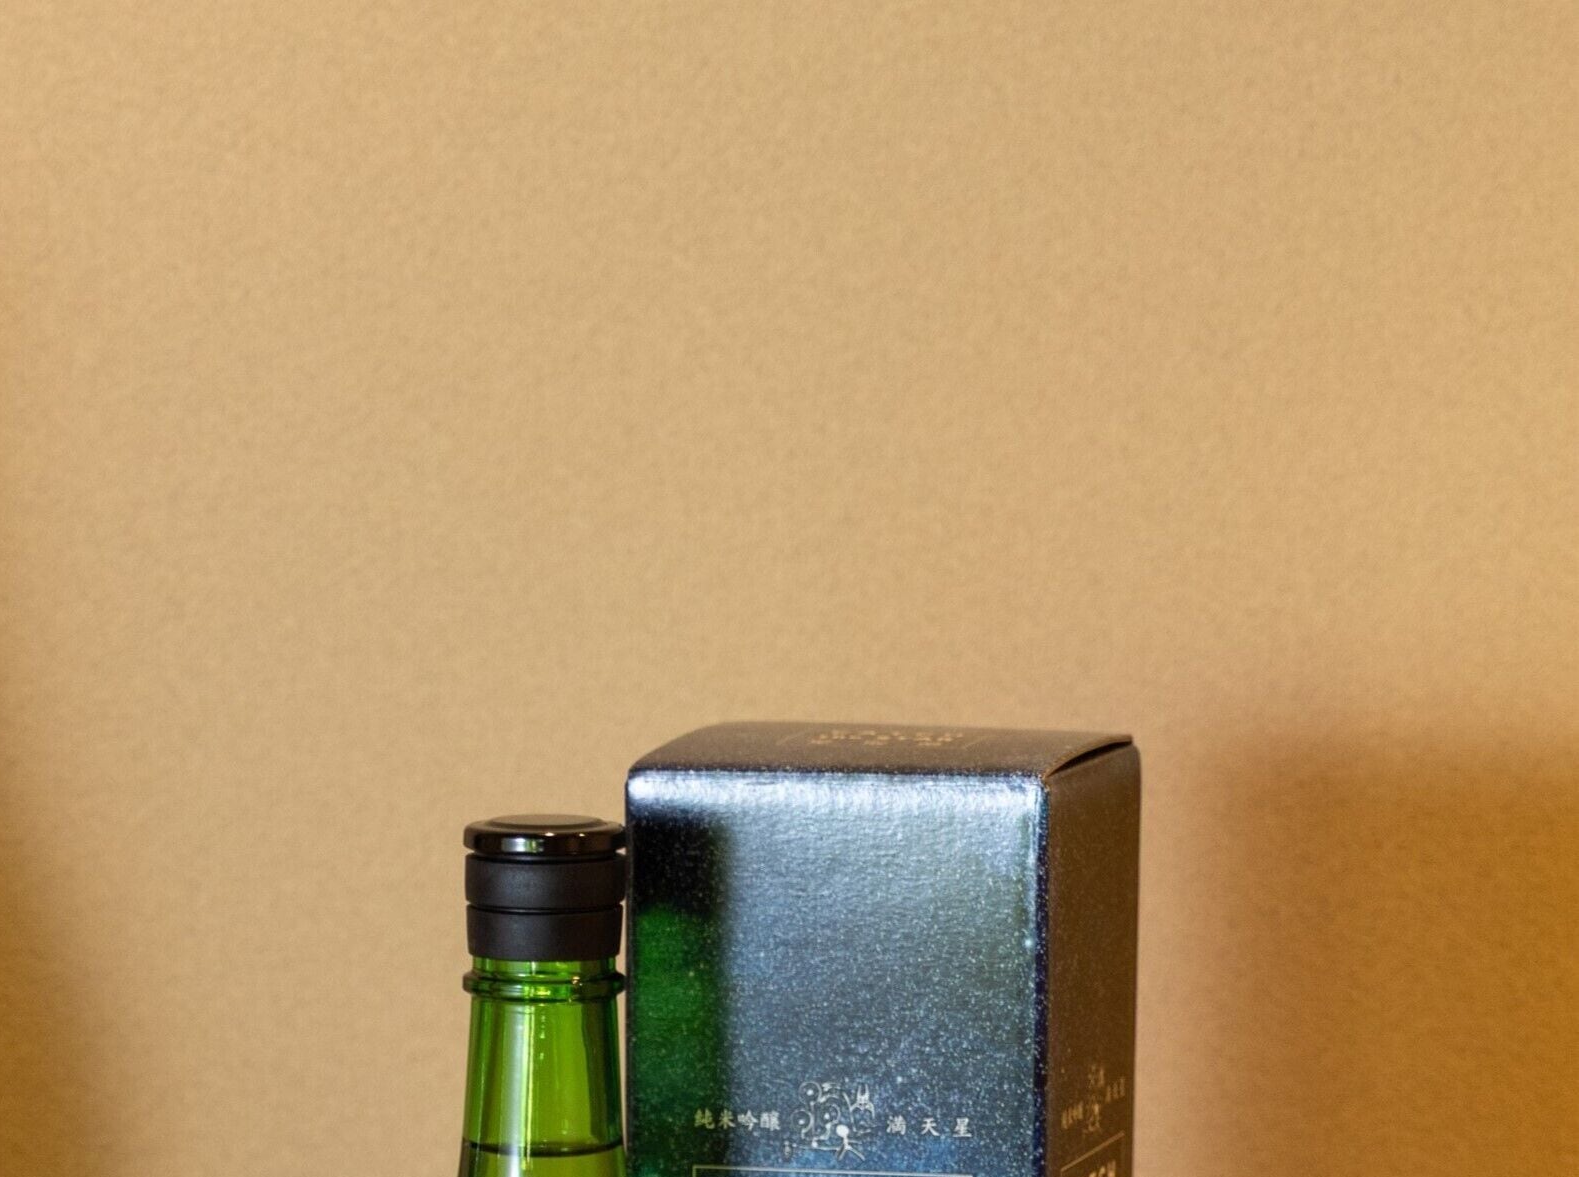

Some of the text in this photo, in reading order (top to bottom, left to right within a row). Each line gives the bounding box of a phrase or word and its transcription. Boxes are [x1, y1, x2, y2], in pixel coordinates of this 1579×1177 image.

[693, 1108, 972, 1138] 純米吟醸 満天星
